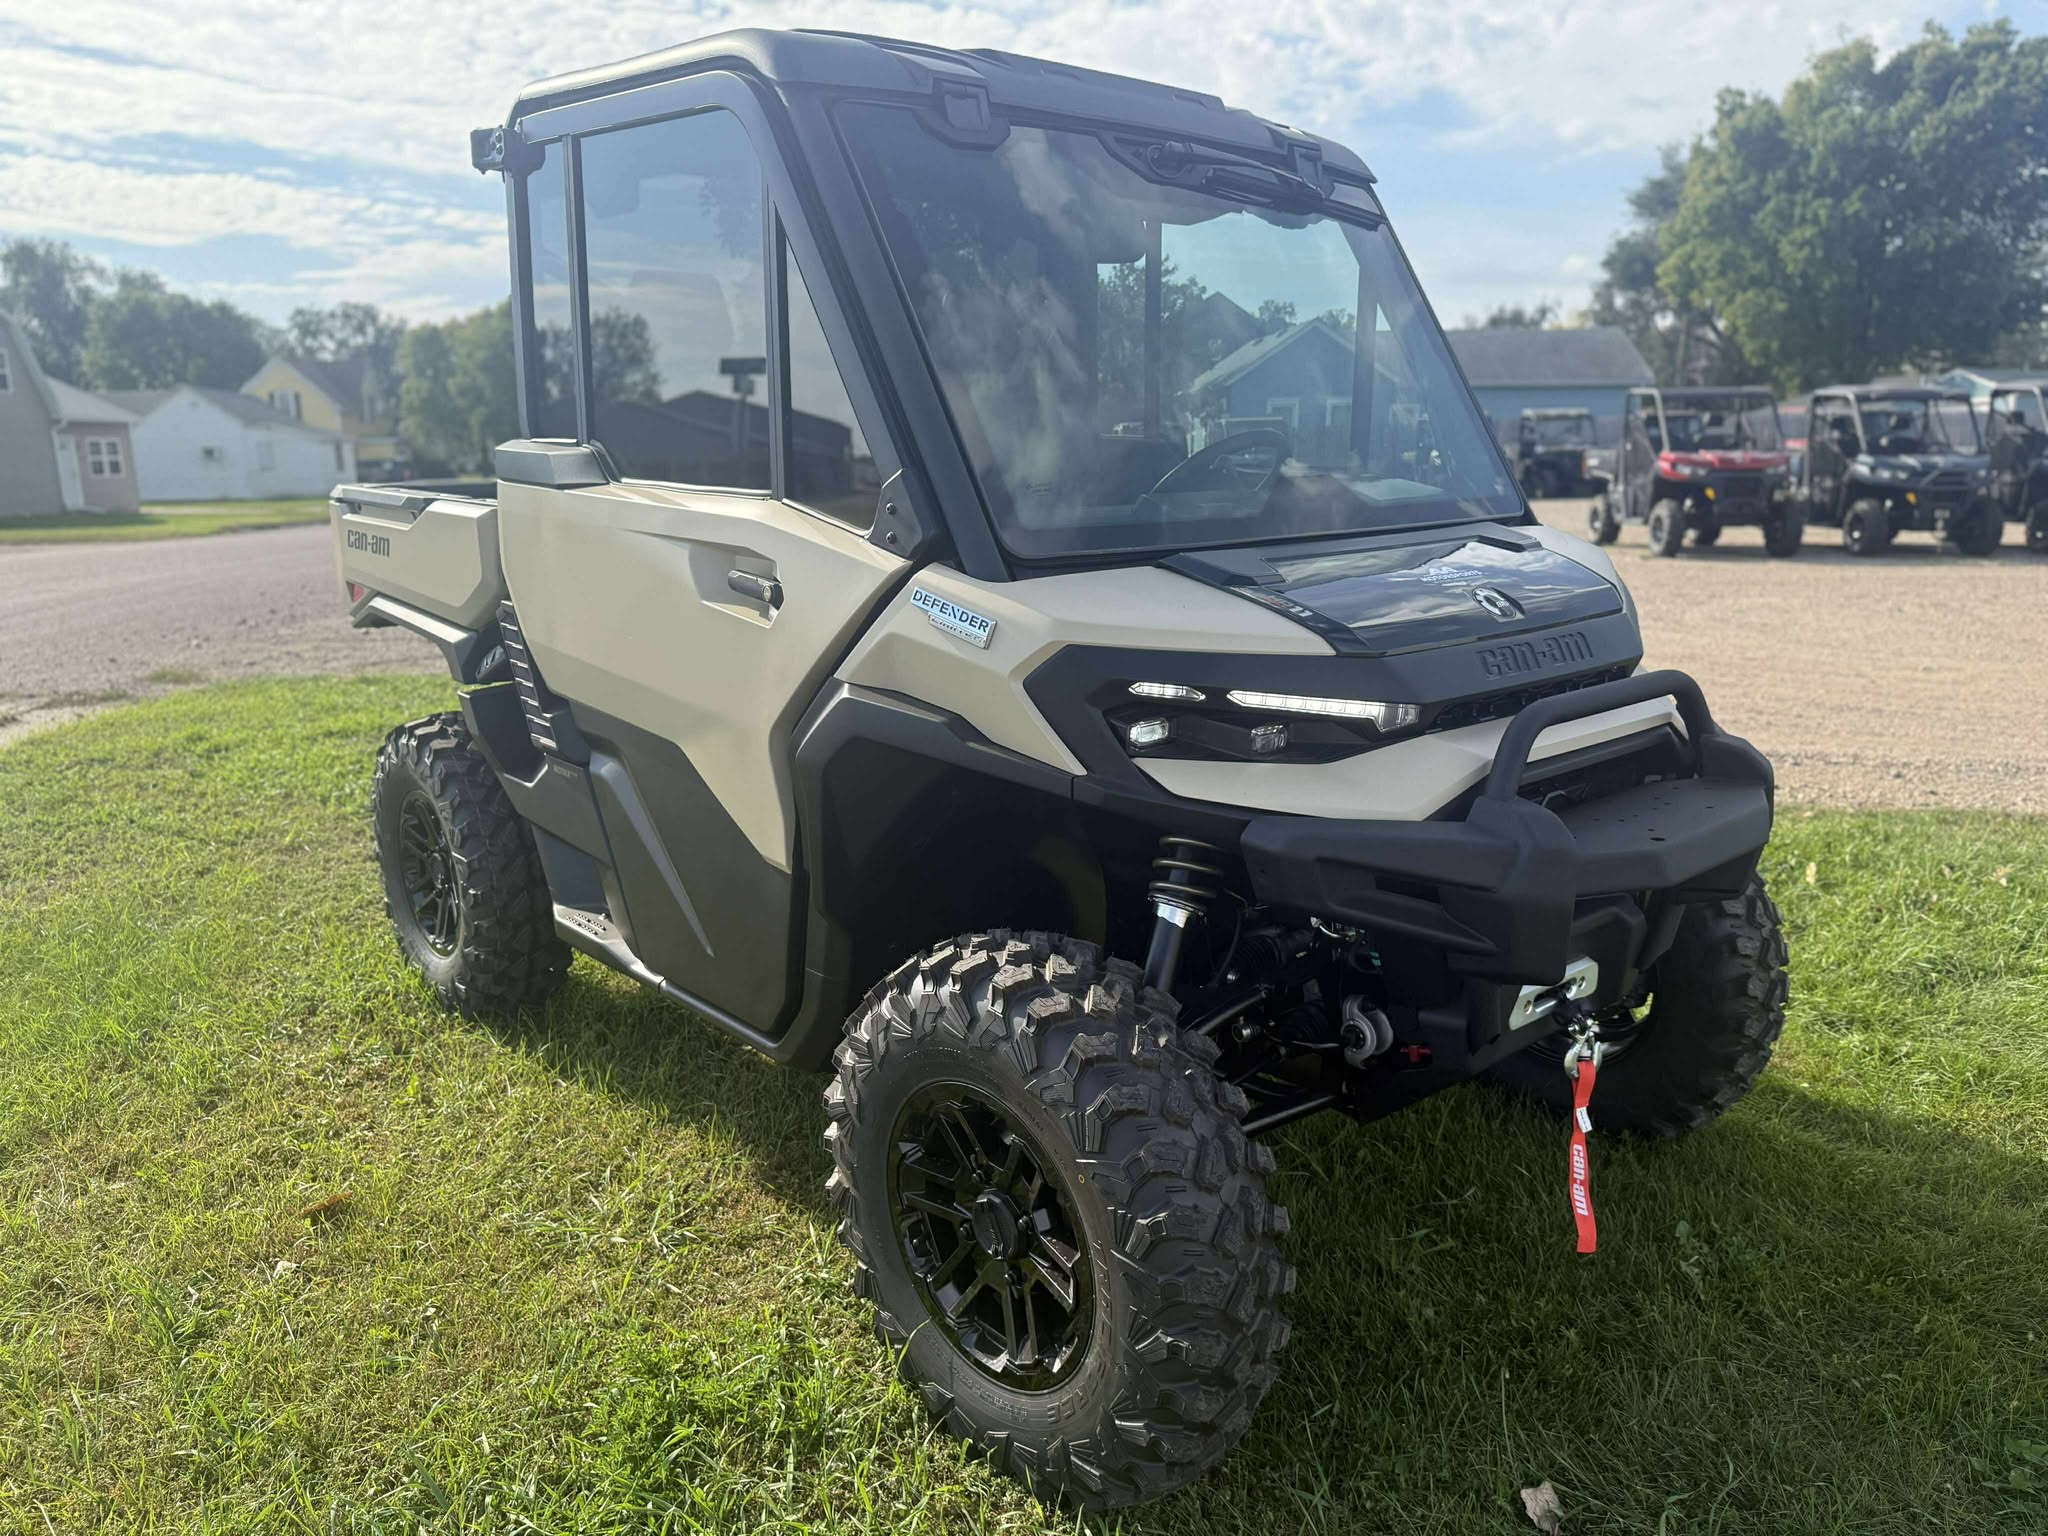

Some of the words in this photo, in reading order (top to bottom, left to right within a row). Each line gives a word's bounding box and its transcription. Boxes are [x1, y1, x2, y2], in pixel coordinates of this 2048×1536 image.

[347, 529, 390, 557] can-am
[912, 590, 989, 633] DEFENDER
[1476, 631, 1593, 679] can-am
[1573, 1144, 1589, 1216] can-am
